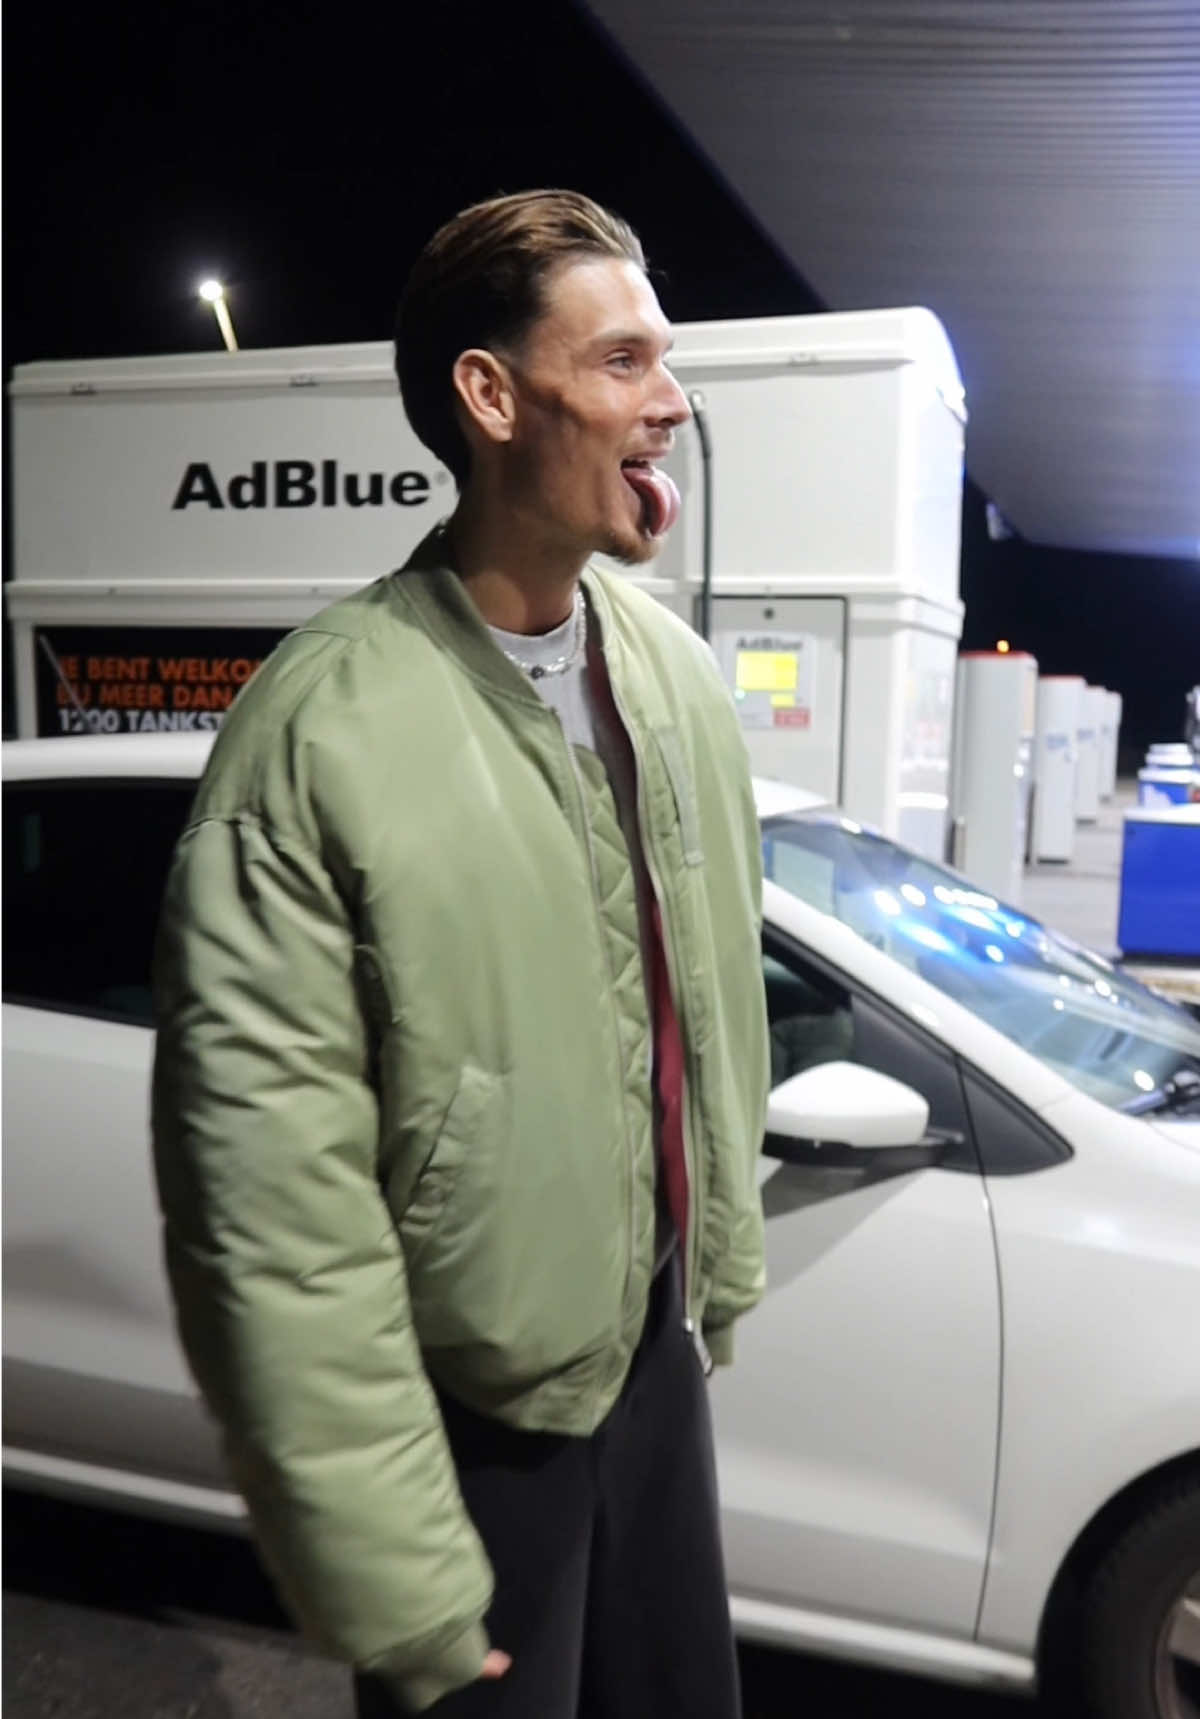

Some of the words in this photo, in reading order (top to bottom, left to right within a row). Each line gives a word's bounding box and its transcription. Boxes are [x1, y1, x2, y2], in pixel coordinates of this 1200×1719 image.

[171, 459, 431, 510] AdBlue
[87, 656, 150, 681] BENT
[99, 684, 164, 708] MEER
[173, 685, 234, 709] DAN
